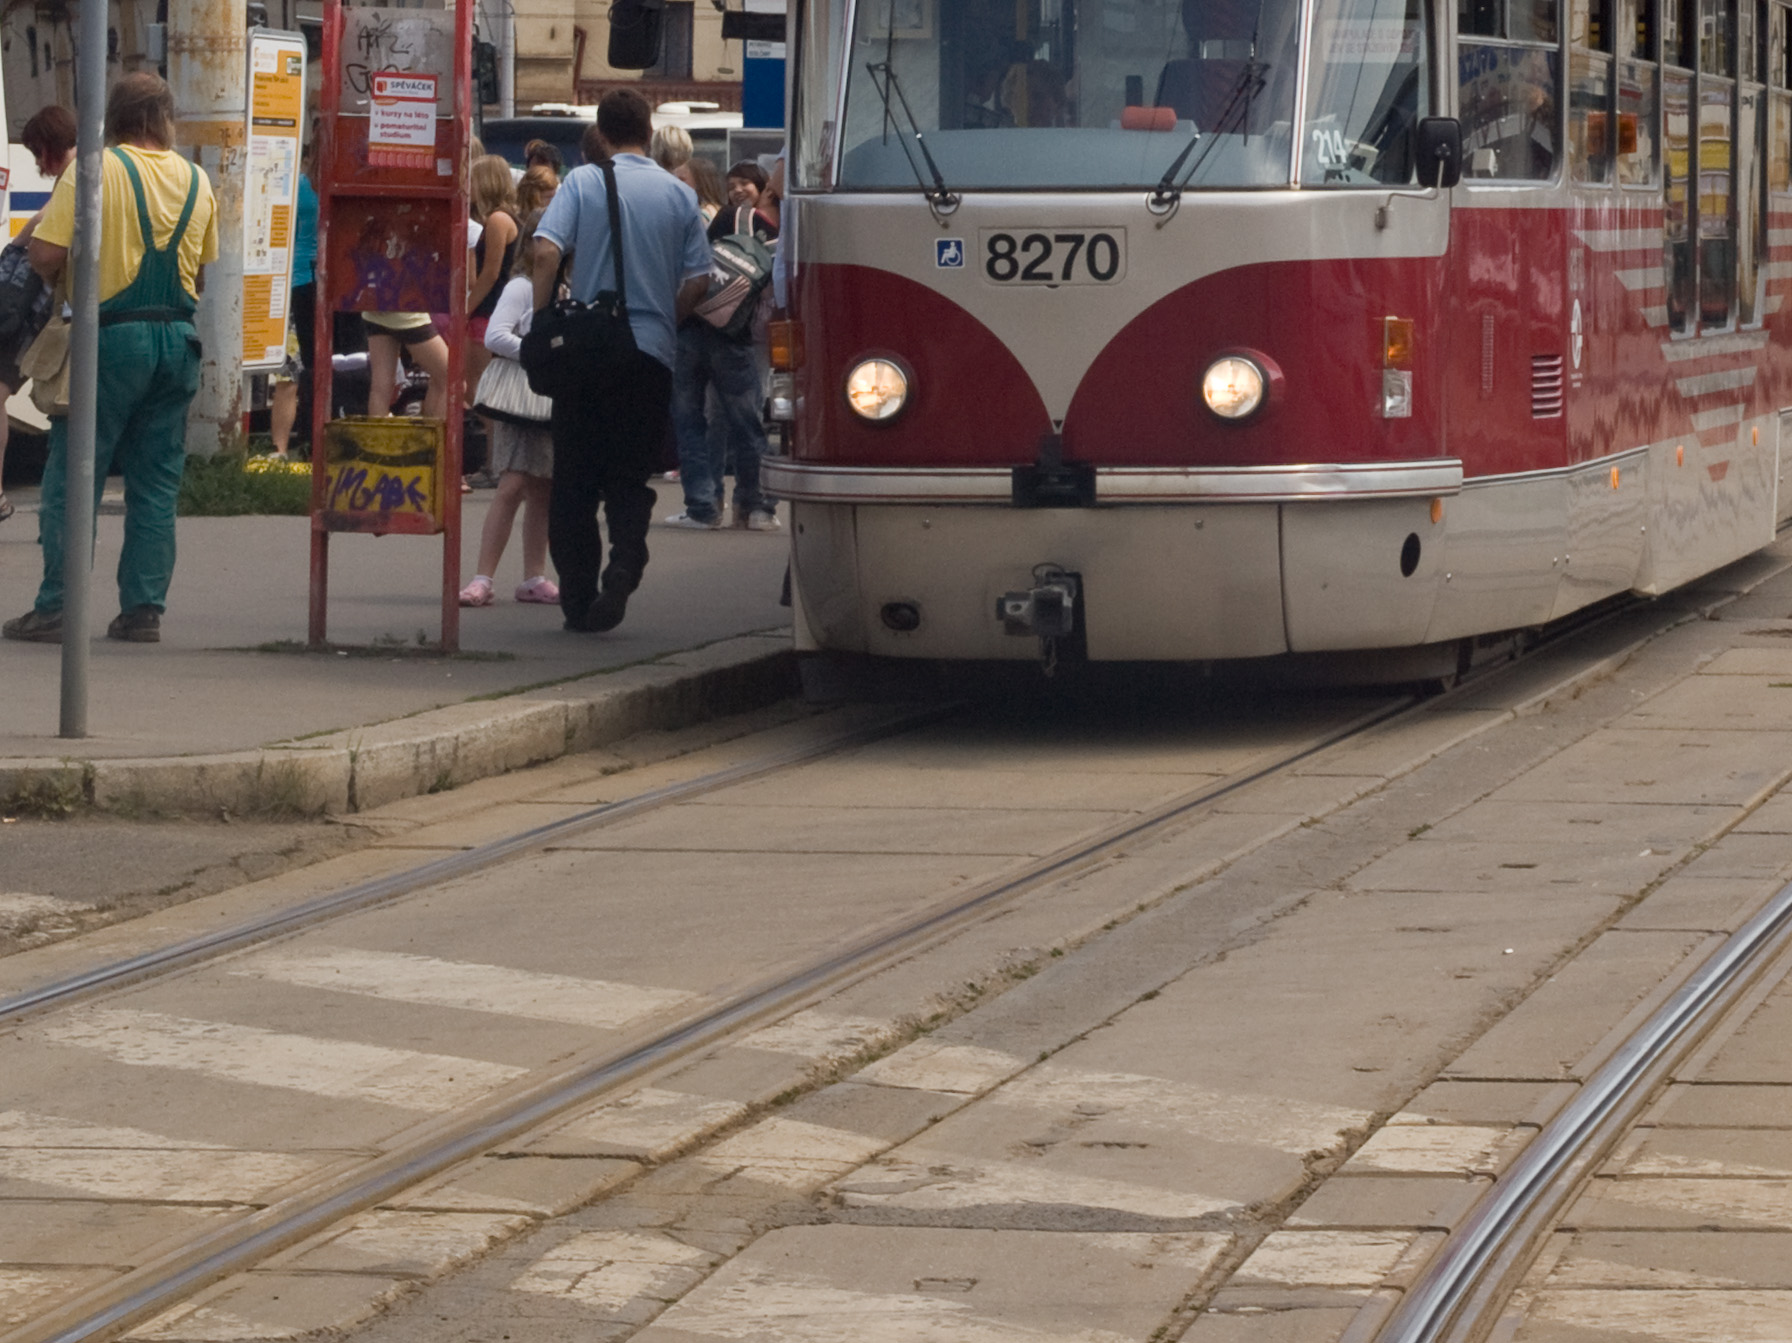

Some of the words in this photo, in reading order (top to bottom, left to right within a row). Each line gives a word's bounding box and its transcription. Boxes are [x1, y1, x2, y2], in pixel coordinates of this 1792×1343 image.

[390, 80, 433, 91] SPĚVÁČEK
[1312, 129, 1347, 165] 214
[986, 233, 1120, 282] 8270
